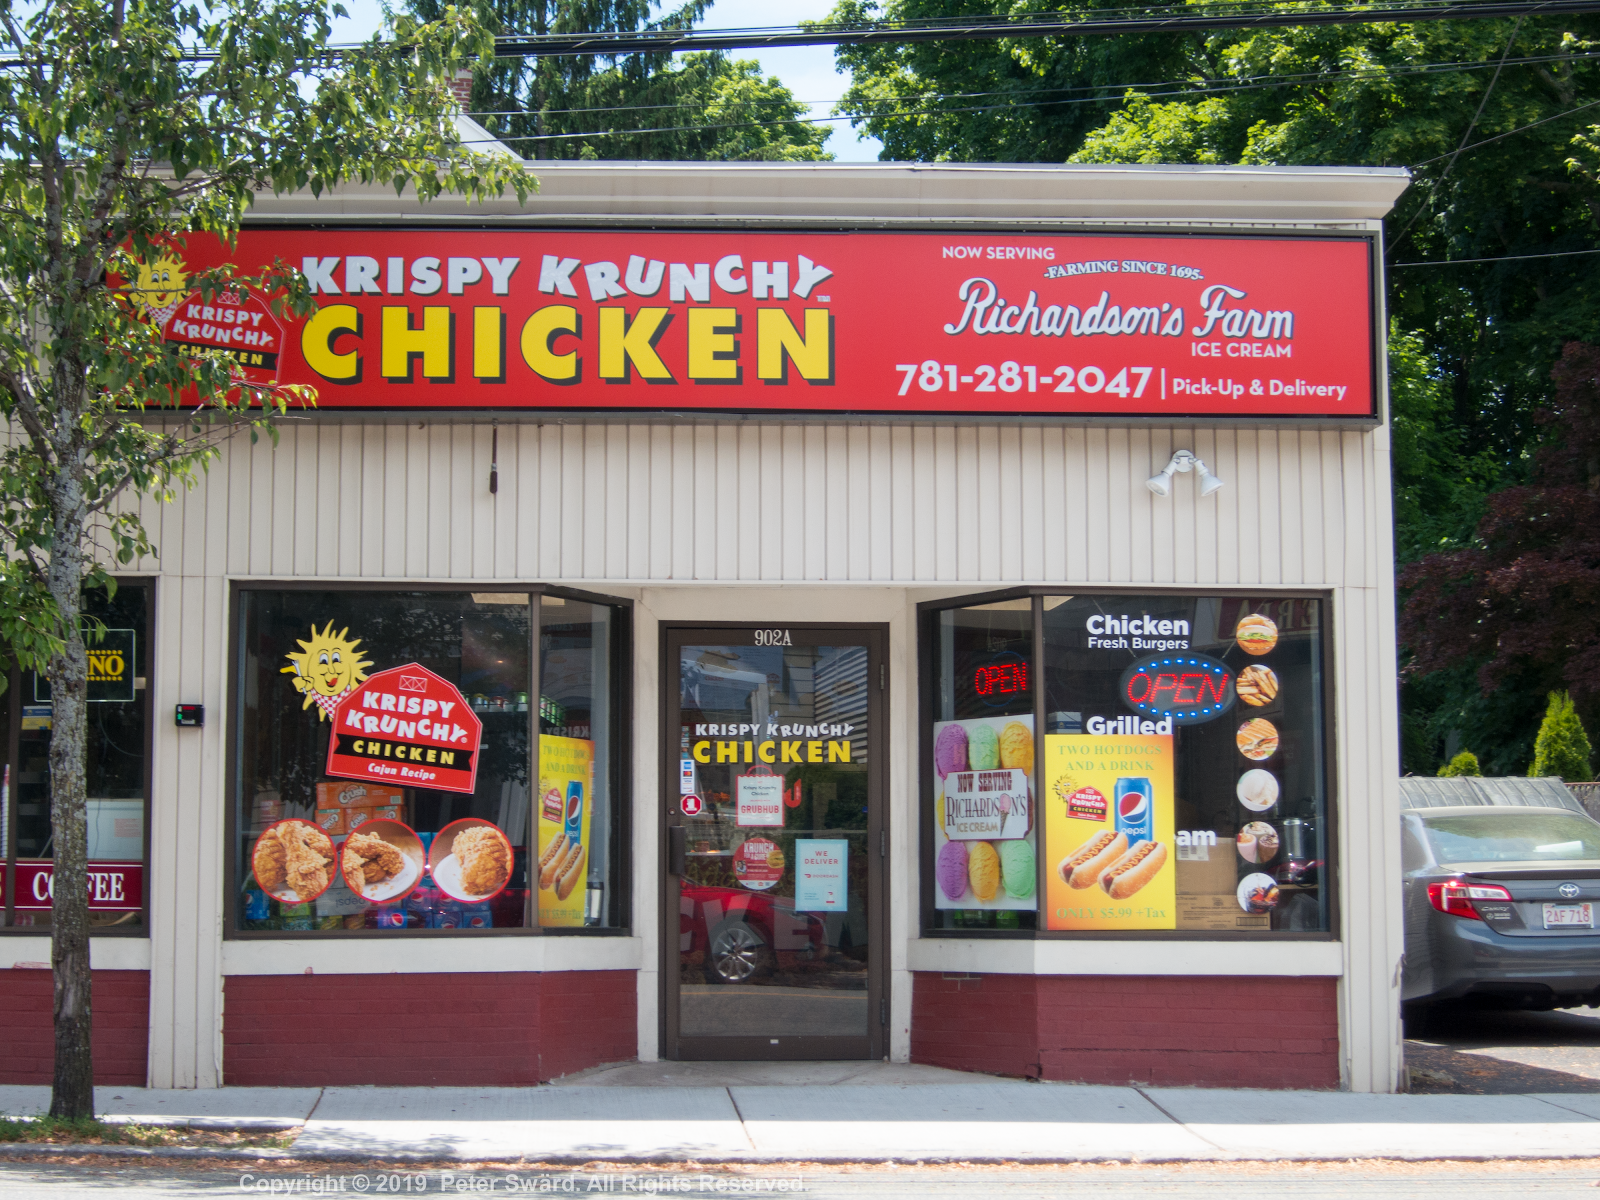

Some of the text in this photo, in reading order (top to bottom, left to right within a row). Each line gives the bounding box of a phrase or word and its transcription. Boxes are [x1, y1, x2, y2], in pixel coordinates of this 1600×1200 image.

[942, 246, 1055, 260] NOW SERVING
[1121, 260, 1168, 275] SINCE
[302, 255, 521, 297] KRISPY
[538, 254, 834, 302] KRUNCHY
[187, 304, 264, 326] KRISPY
[943, 277, 1294, 339] Richardson's Farm
[172, 319, 274, 346] KRUNCHY
[301, 304, 835, 386] CHICKEN
[1191, 342, 1292, 358] ICE CREAM
[178, 344, 263, 366] CHKEN
[895, 360, 1347, 401] 781-281-2047 Pick-Up & Delivery
[1086, 614, 1189, 636] Chicken
[754, 629, 793, 646] 902A
[1088, 636, 1189, 651] Fresh Burgers
[975, 662, 1027, 695] OPEN
[1127, 673, 1229, 703] OPEN
[362, 690, 456, 719] KRISPY
[345, 708, 468, 743] KRUNCHY
[695, 722, 855, 738] KRISPY KRUNCHY
[1086, 715, 1173, 735] Grilled
[352, 739, 455, 765] CHICKEN
[693, 740, 851, 763] CHICKEN
[1057, 744, 1162, 755] TWO HOTDOGS
[367, 763, 436, 781] Cajun Recipe
[1065, 760, 1155, 770] AND A DRINK
[957, 771, 1012, 793] NOW SERVING
[338, 785, 367, 804] Crush
[1075, 793, 1102, 801] KRISPY
[741, 805, 779, 814] GRUBHUB
[1073, 806, 1103, 814] CHICKEN
[957, 822, 998, 832] ICE CREAM
[1121, 826, 1147, 836] pepsi
[1174, 830, 1216, 846] am
[1056, 907, 1166, 919] ONLY $5.99 +Tax
[1546, 909, 1590, 923] 2AF 718
